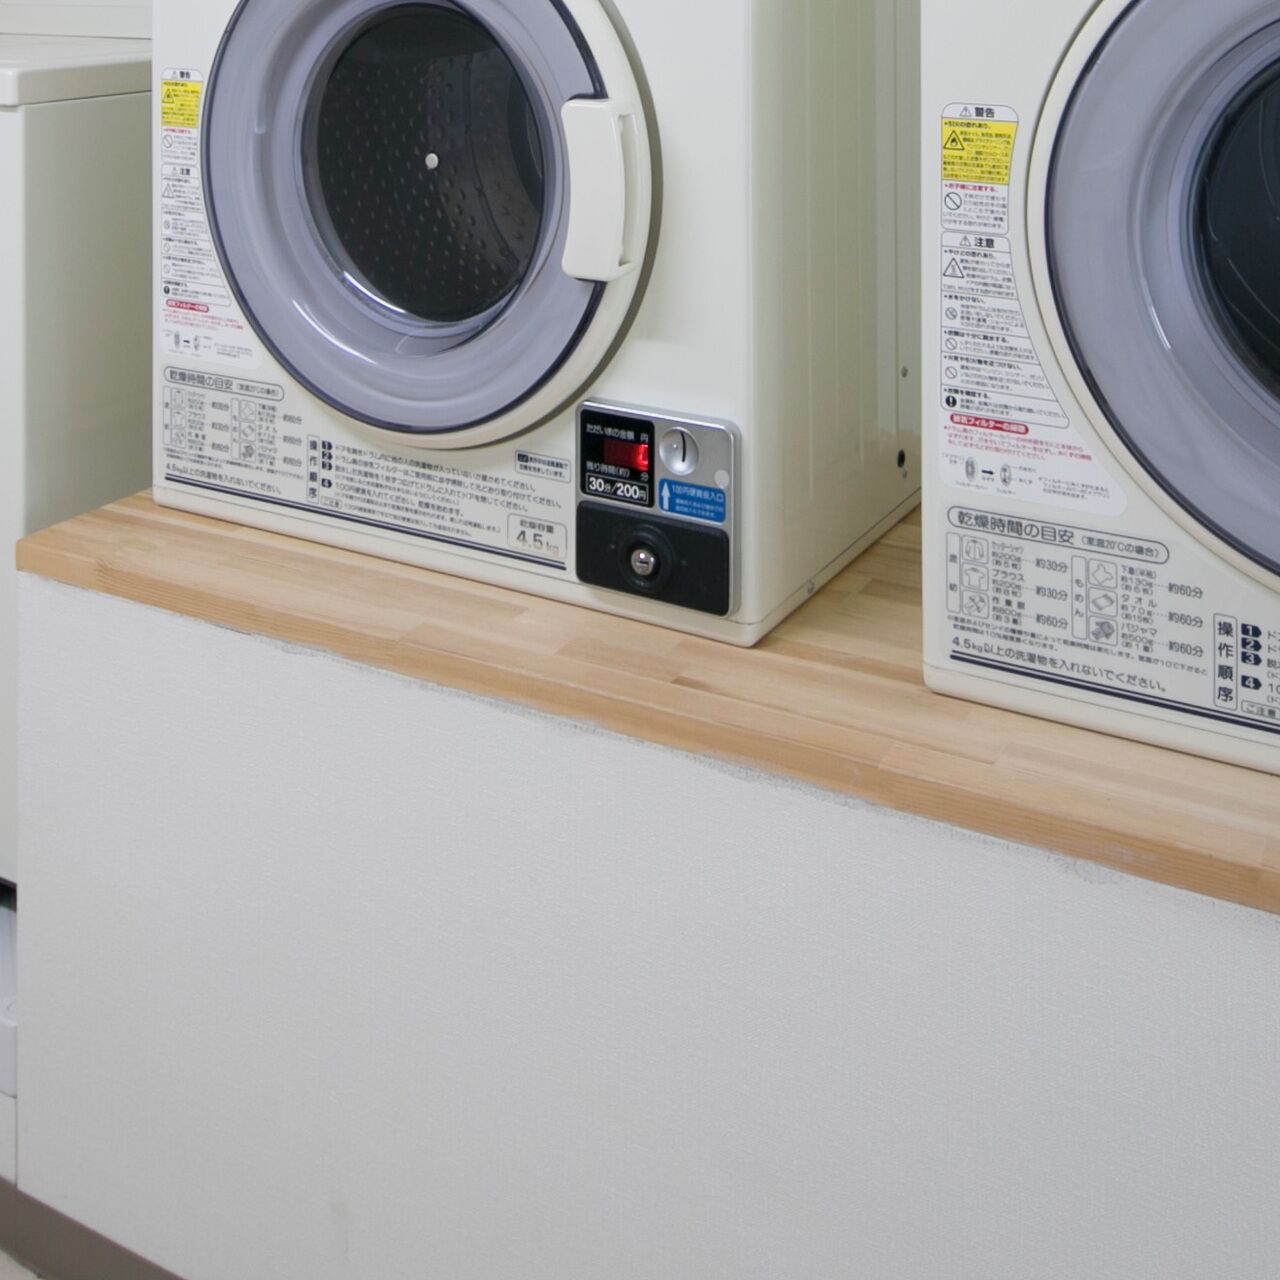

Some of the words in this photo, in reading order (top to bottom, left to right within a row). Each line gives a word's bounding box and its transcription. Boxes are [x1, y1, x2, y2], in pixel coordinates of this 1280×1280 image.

[974, 237, 995, 249] 注意
[589, 476, 647, 501] 30分/200円
[957, 510, 1075, 546] 乾燥時間の目安
[1036, 558, 1068, 573] 約30分
[992, 569, 1025, 581] ブラウス
[1036, 586, 1068, 601] 約30分
[1169, 582, 1203, 599] 約60分
[1121, 594, 1157, 608] タオル
[1036, 614, 1068, 630] 約60分
[1169, 612, 1203, 628] 約60分
[1121, 623, 1157, 636] パジャマ
[1169, 641, 1204, 658] 約60分
[952, 636, 1167, 693] 4.5kg以上の洗濯物を入れないでください。
[1217, 621, 1234, 703] 操作順序
